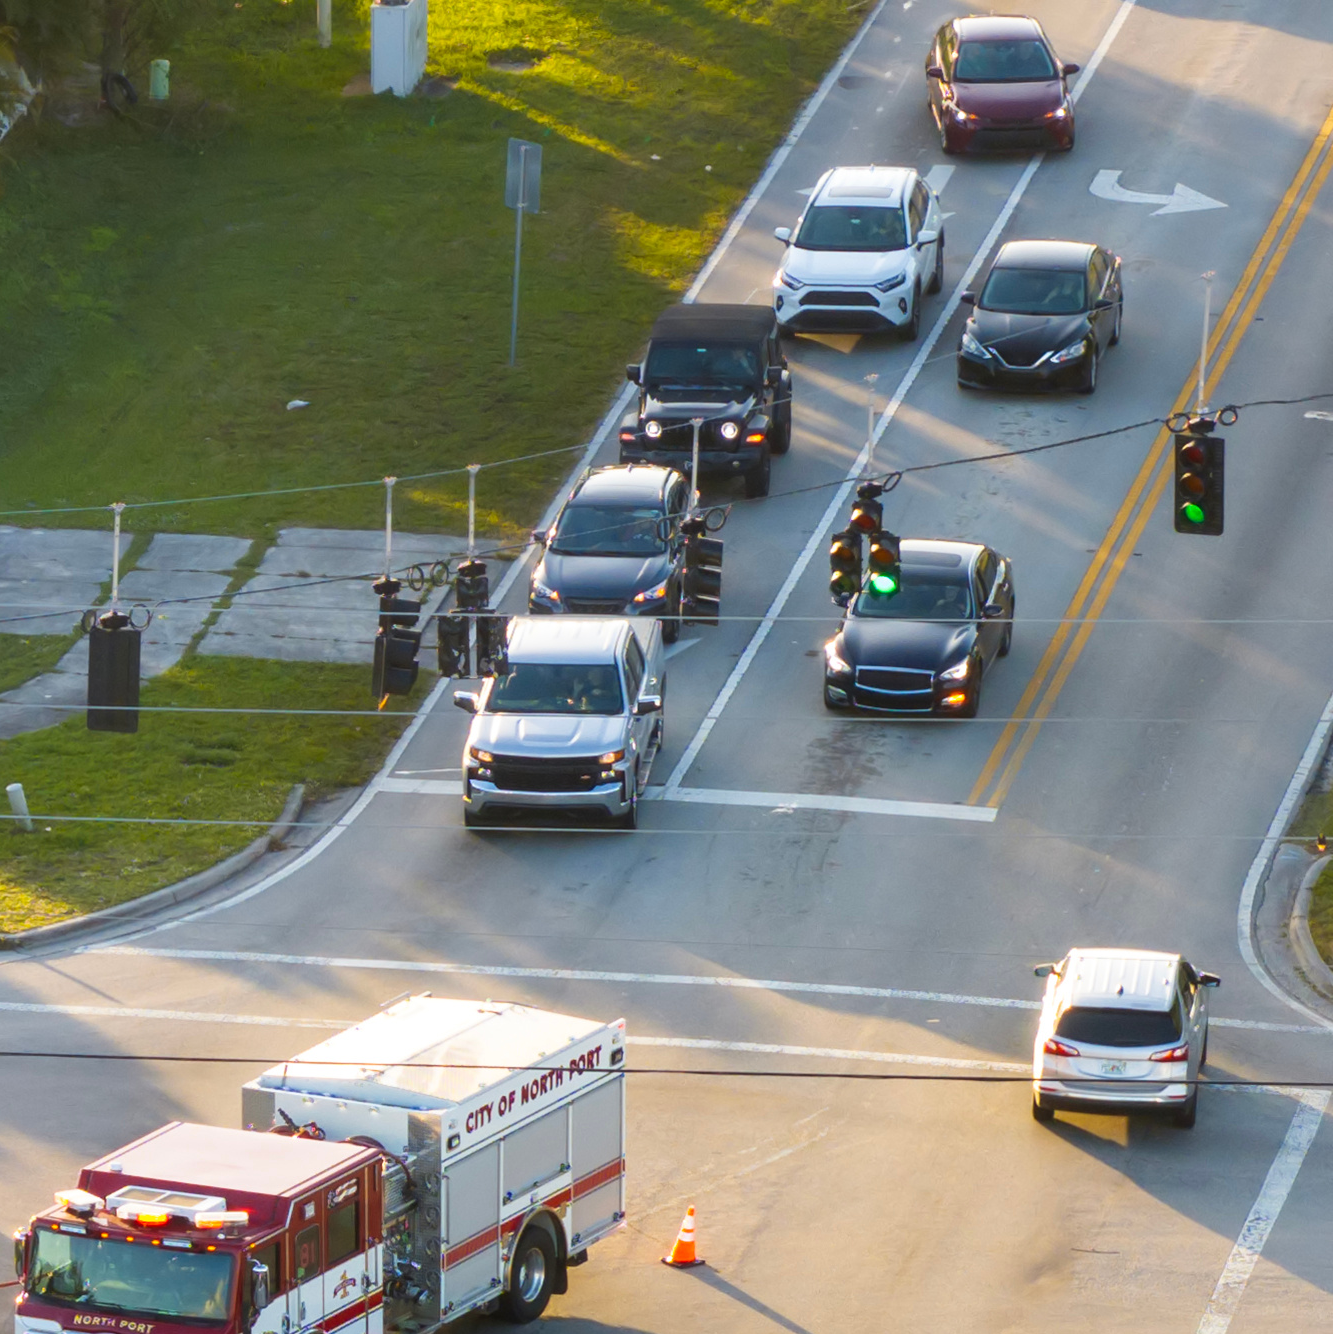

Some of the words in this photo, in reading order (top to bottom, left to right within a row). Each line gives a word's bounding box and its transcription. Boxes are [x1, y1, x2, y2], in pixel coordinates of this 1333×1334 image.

[465, 1101, 494, 1134] CITY
[498, 1089, 516, 1117] OF
[521, 1065, 563, 1106] NORTH
[569, 1044, 602, 1081] PORT
[73, 1313, 115, 1327] NORTH
[119, 1320, 156, 1334] PORT
